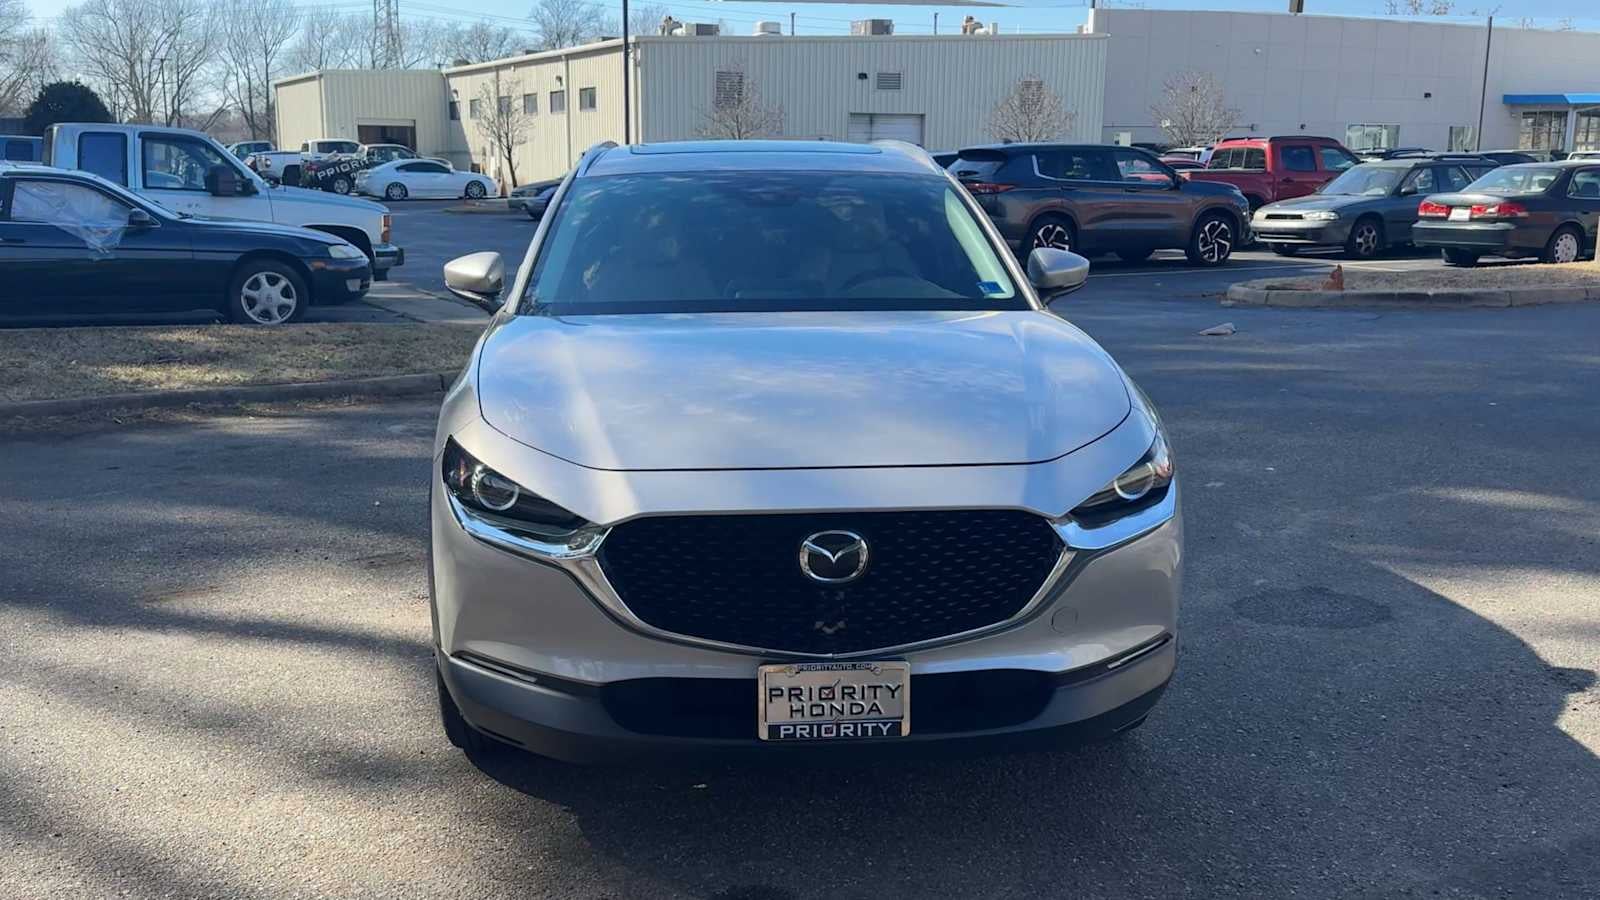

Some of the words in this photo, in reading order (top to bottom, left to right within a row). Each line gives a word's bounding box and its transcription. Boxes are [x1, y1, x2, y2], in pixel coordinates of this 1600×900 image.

[798, 663, 873, 671] PRIORITYAUTO.COM
[769, 684, 902, 703] PRIORITY
[790, 702, 883, 718] HONDA
[780, 723, 892, 738] PRIORITY
